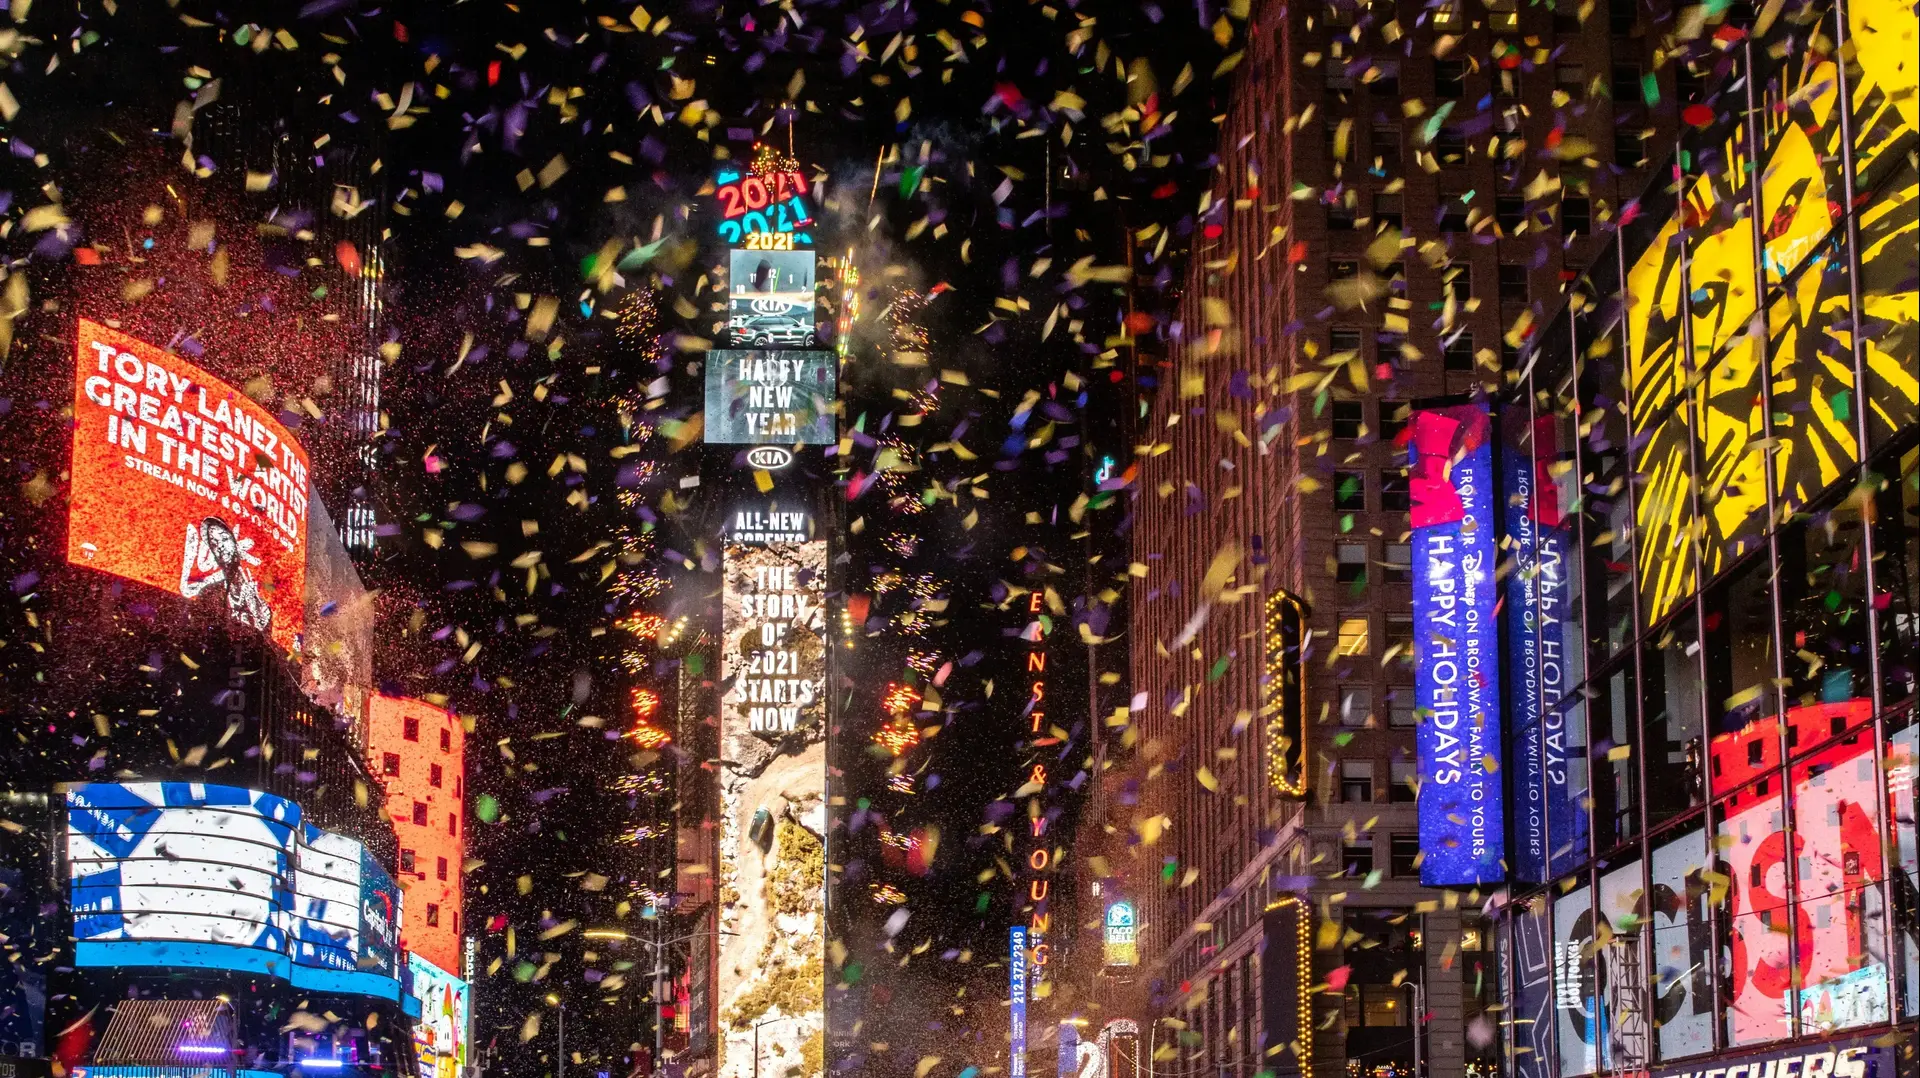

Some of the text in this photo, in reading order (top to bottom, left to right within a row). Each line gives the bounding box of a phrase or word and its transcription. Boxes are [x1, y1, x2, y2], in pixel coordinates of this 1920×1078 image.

[746, 232, 794, 250] 2021
[758, 299, 787, 311] KIA
[749, 386, 793, 409] NEW
[91, 341, 307, 492] TORY LANEZ THE
[745, 412, 796, 436] YEAR
[85, 376, 307, 522] GREATEST ARTIST
[108, 415, 147, 455] IN
[156, 433, 220, 487] THE
[755, 452, 785, 465] KIA
[125, 455, 218, 501] STREAM NOW
[1461, 469, 1474, 510] FROM
[736, 512, 804, 531] ALL-NEW
[755, 566, 794, 590] THE
[741, 595, 809, 619] STORY
[1465, 610, 1479, 633] ON
[762, 622, 789, 647] OF
[750, 651, 798, 675] 2021
[1030, 592, 1045, 732] ERNST
[1428, 535, 1462, 786] HAPPY HOLIDAYS
[735, 679, 814, 704] STARTS
[1466, 639, 1482, 720] BROADWAY
[750, 707, 799, 732] NOW
[1469, 726, 1483, 777] FAMILY
[1029, 764, 1045, 784] &
[1471, 782, 1483, 801] TO
[1030, 816, 1049, 965] YOUNG
[1107, 927, 1133, 935] TACO
[1013, 931, 1024, 1004] 212.372.2349
[1501, 938, 1510, 1007] NEWS
